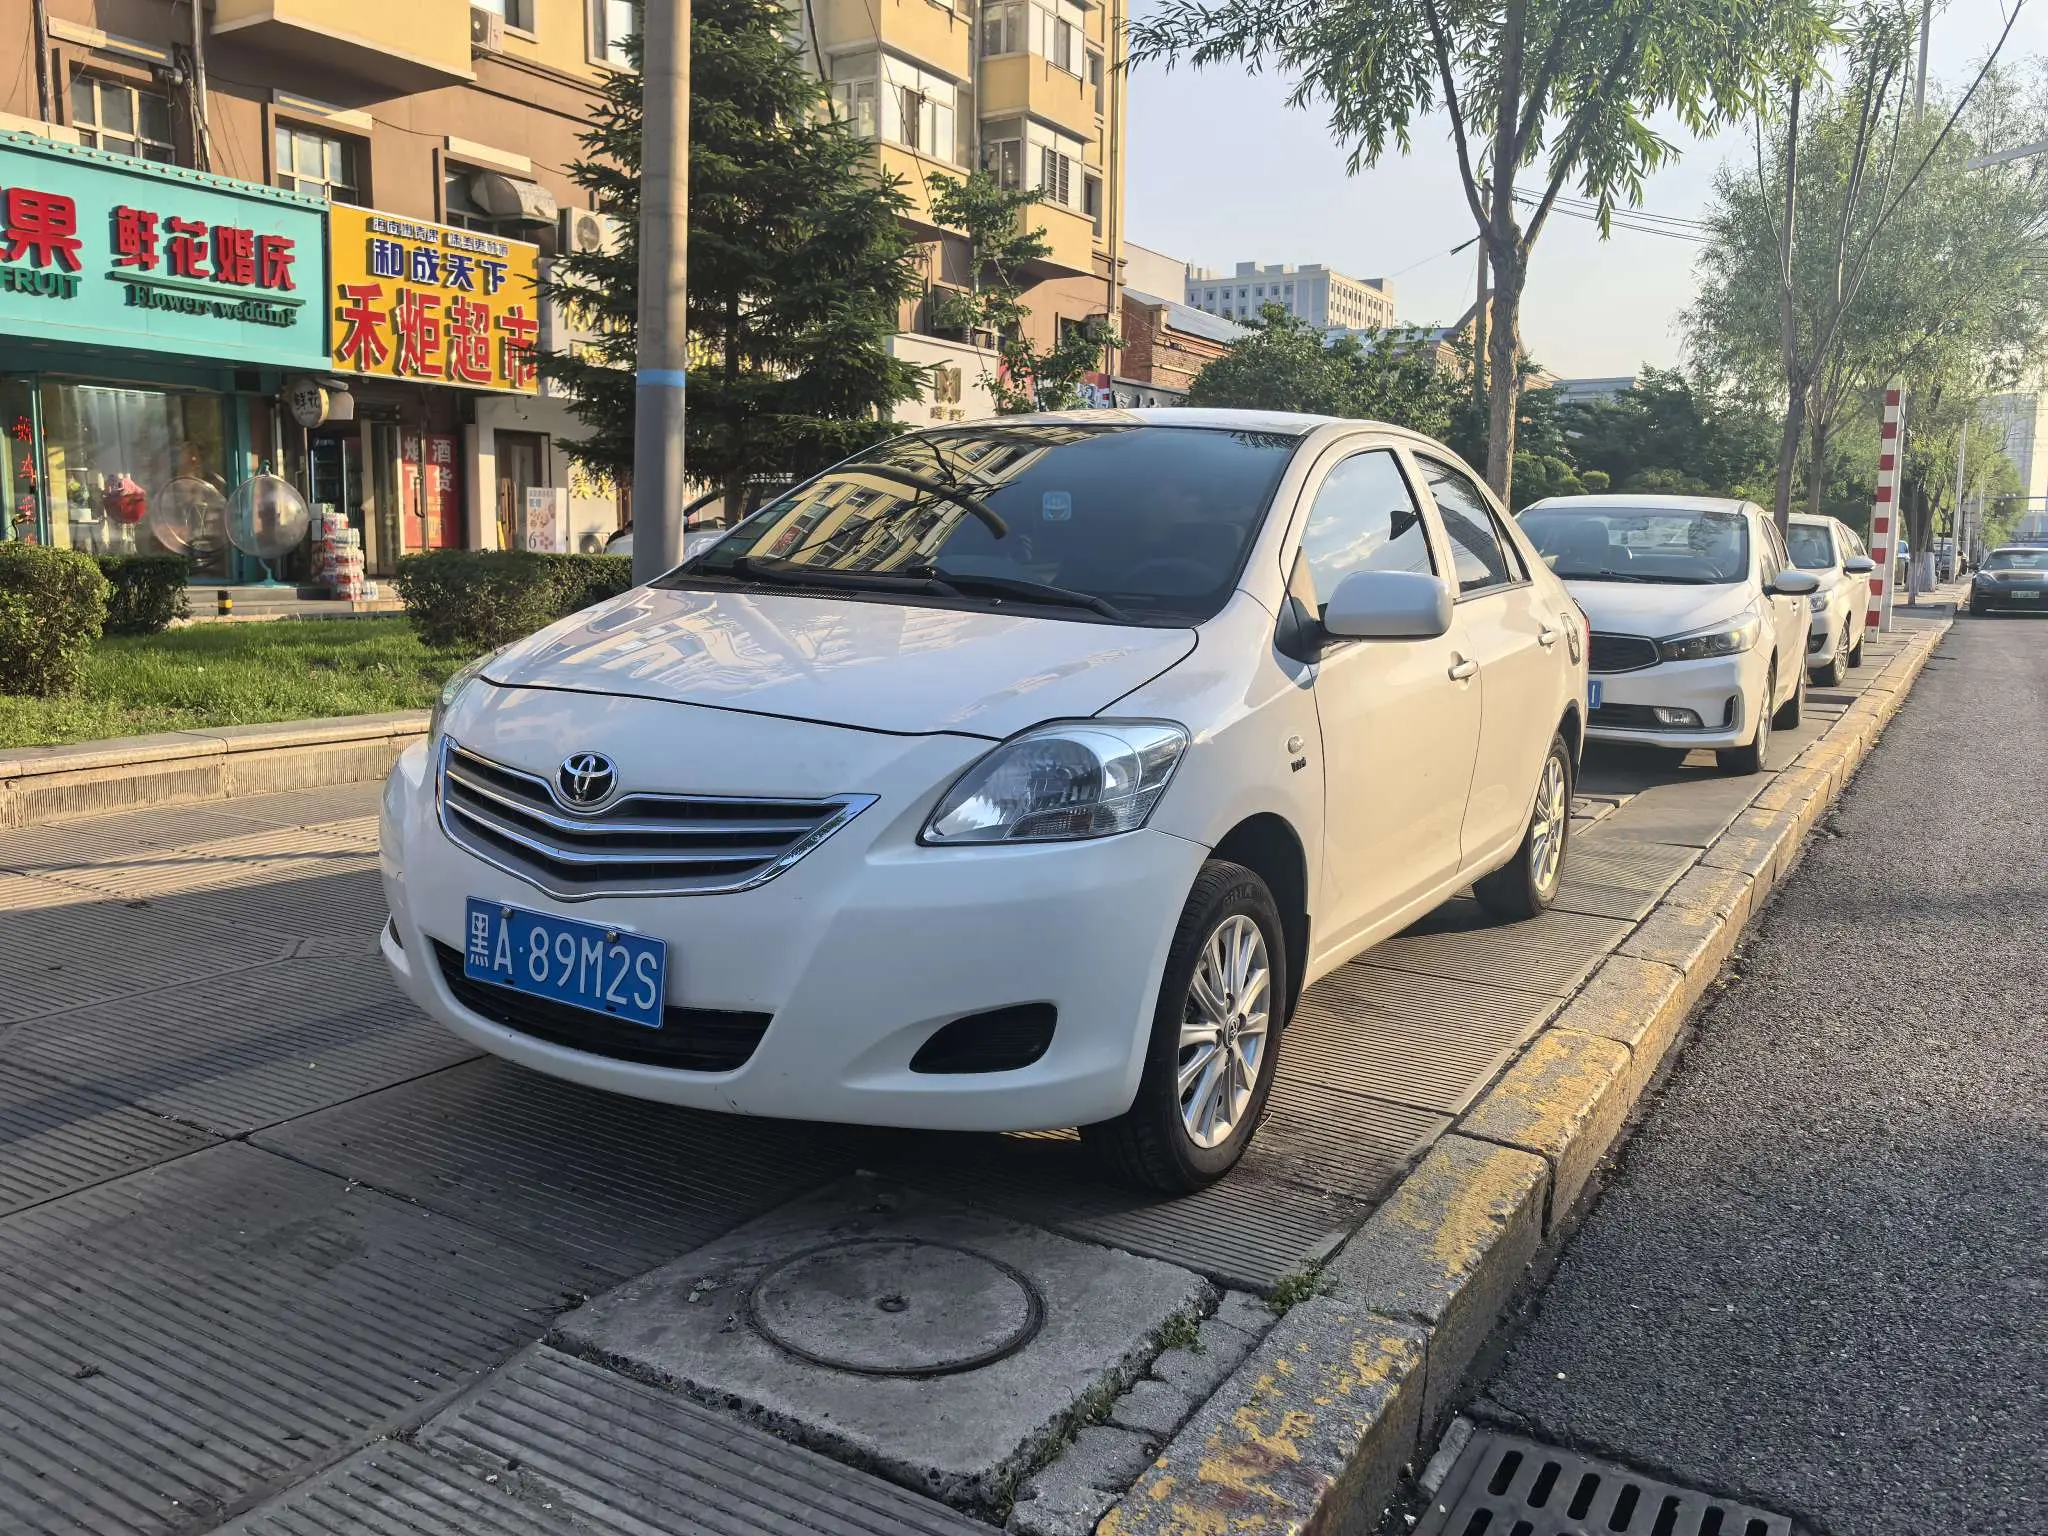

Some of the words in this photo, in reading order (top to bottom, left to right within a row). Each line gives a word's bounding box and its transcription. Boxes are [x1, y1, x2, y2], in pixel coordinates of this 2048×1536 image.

[0, 186, 82, 272] 果
[115, 205, 296, 290] 鲜花婚庆
[374, 238, 508, 294] 和成天下
[0, 265, 82, 297] FRUIT
[127, 285, 213, 315] Flowers
[217, 300, 298, 327] wedding
[342, 283, 539, 390] 禾炬超市
[470, 911, 658, 1010] 黑A·89M2S
